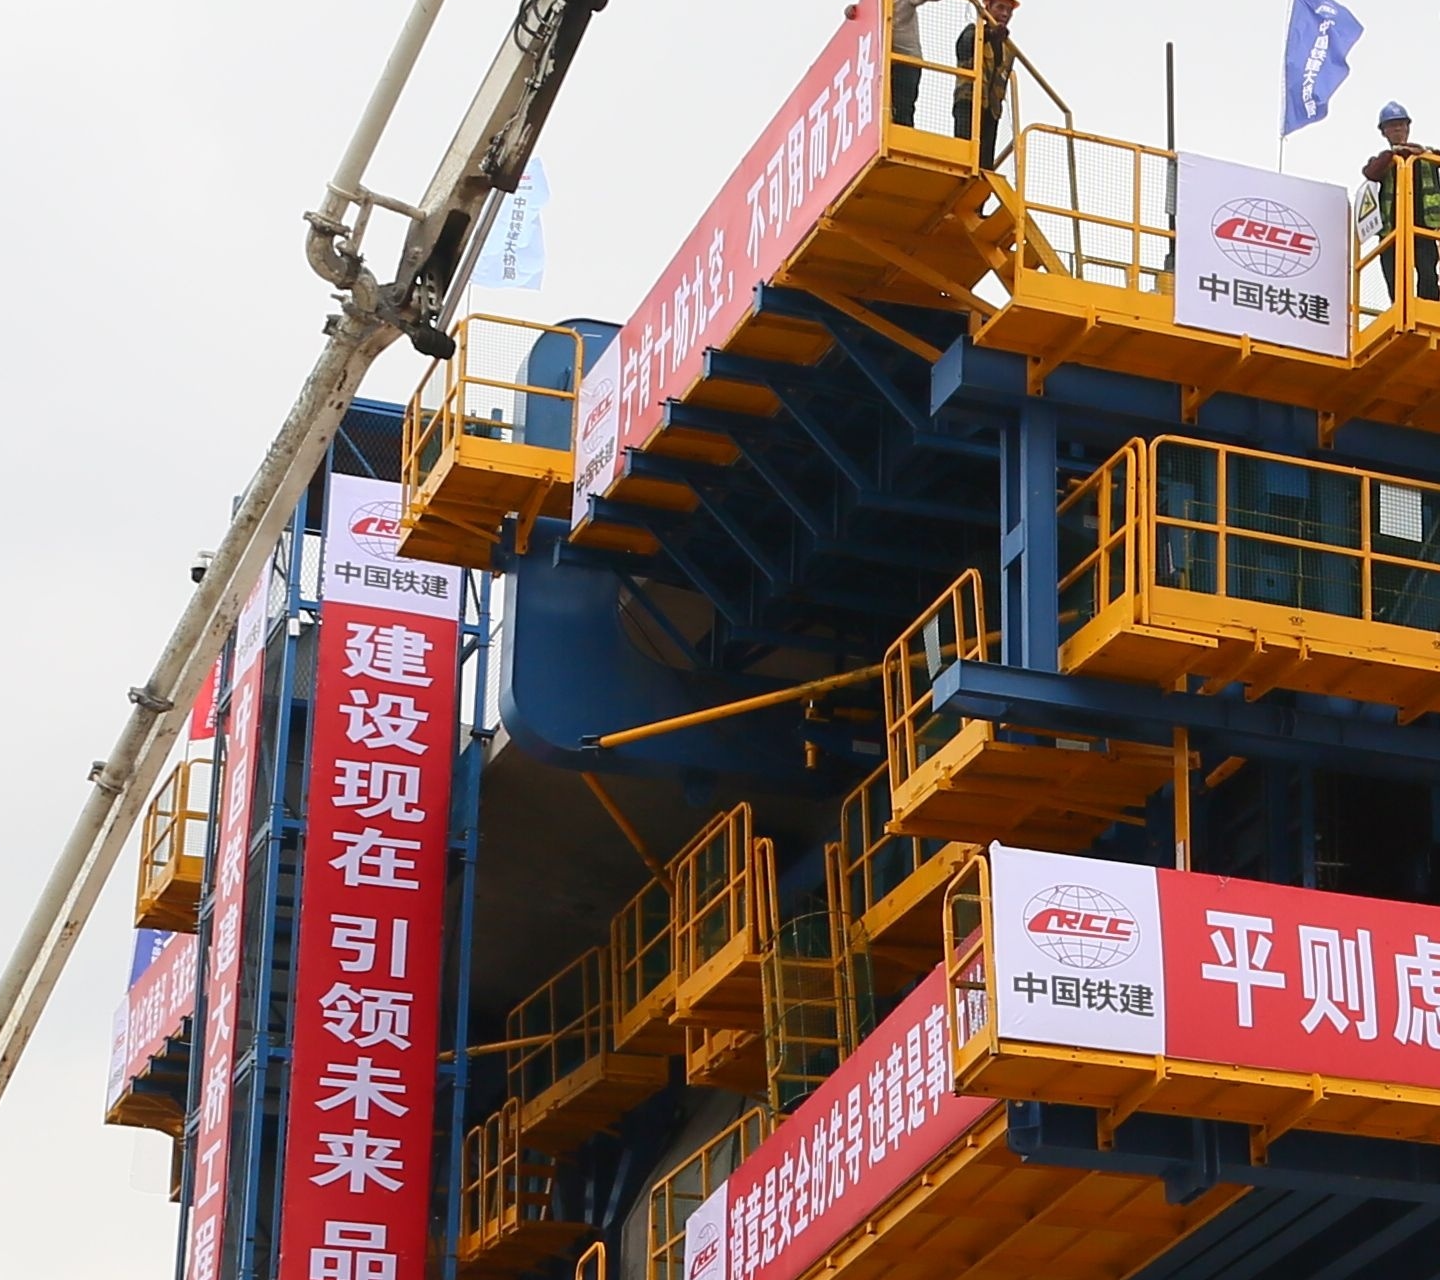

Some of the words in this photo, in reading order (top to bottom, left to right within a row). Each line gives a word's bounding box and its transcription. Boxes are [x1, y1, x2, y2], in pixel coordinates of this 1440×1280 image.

[1198, 272, 1331, 326] 中国铁建
[576, 436, 615, 497] 中国铁建
[334, 560, 449, 600] 中国铁建
[331, 621, 435, 890] 建设现在
[1013, 971, 1156, 1018] 中国铁建
[310, 915, 411, 1194] 引领未来
